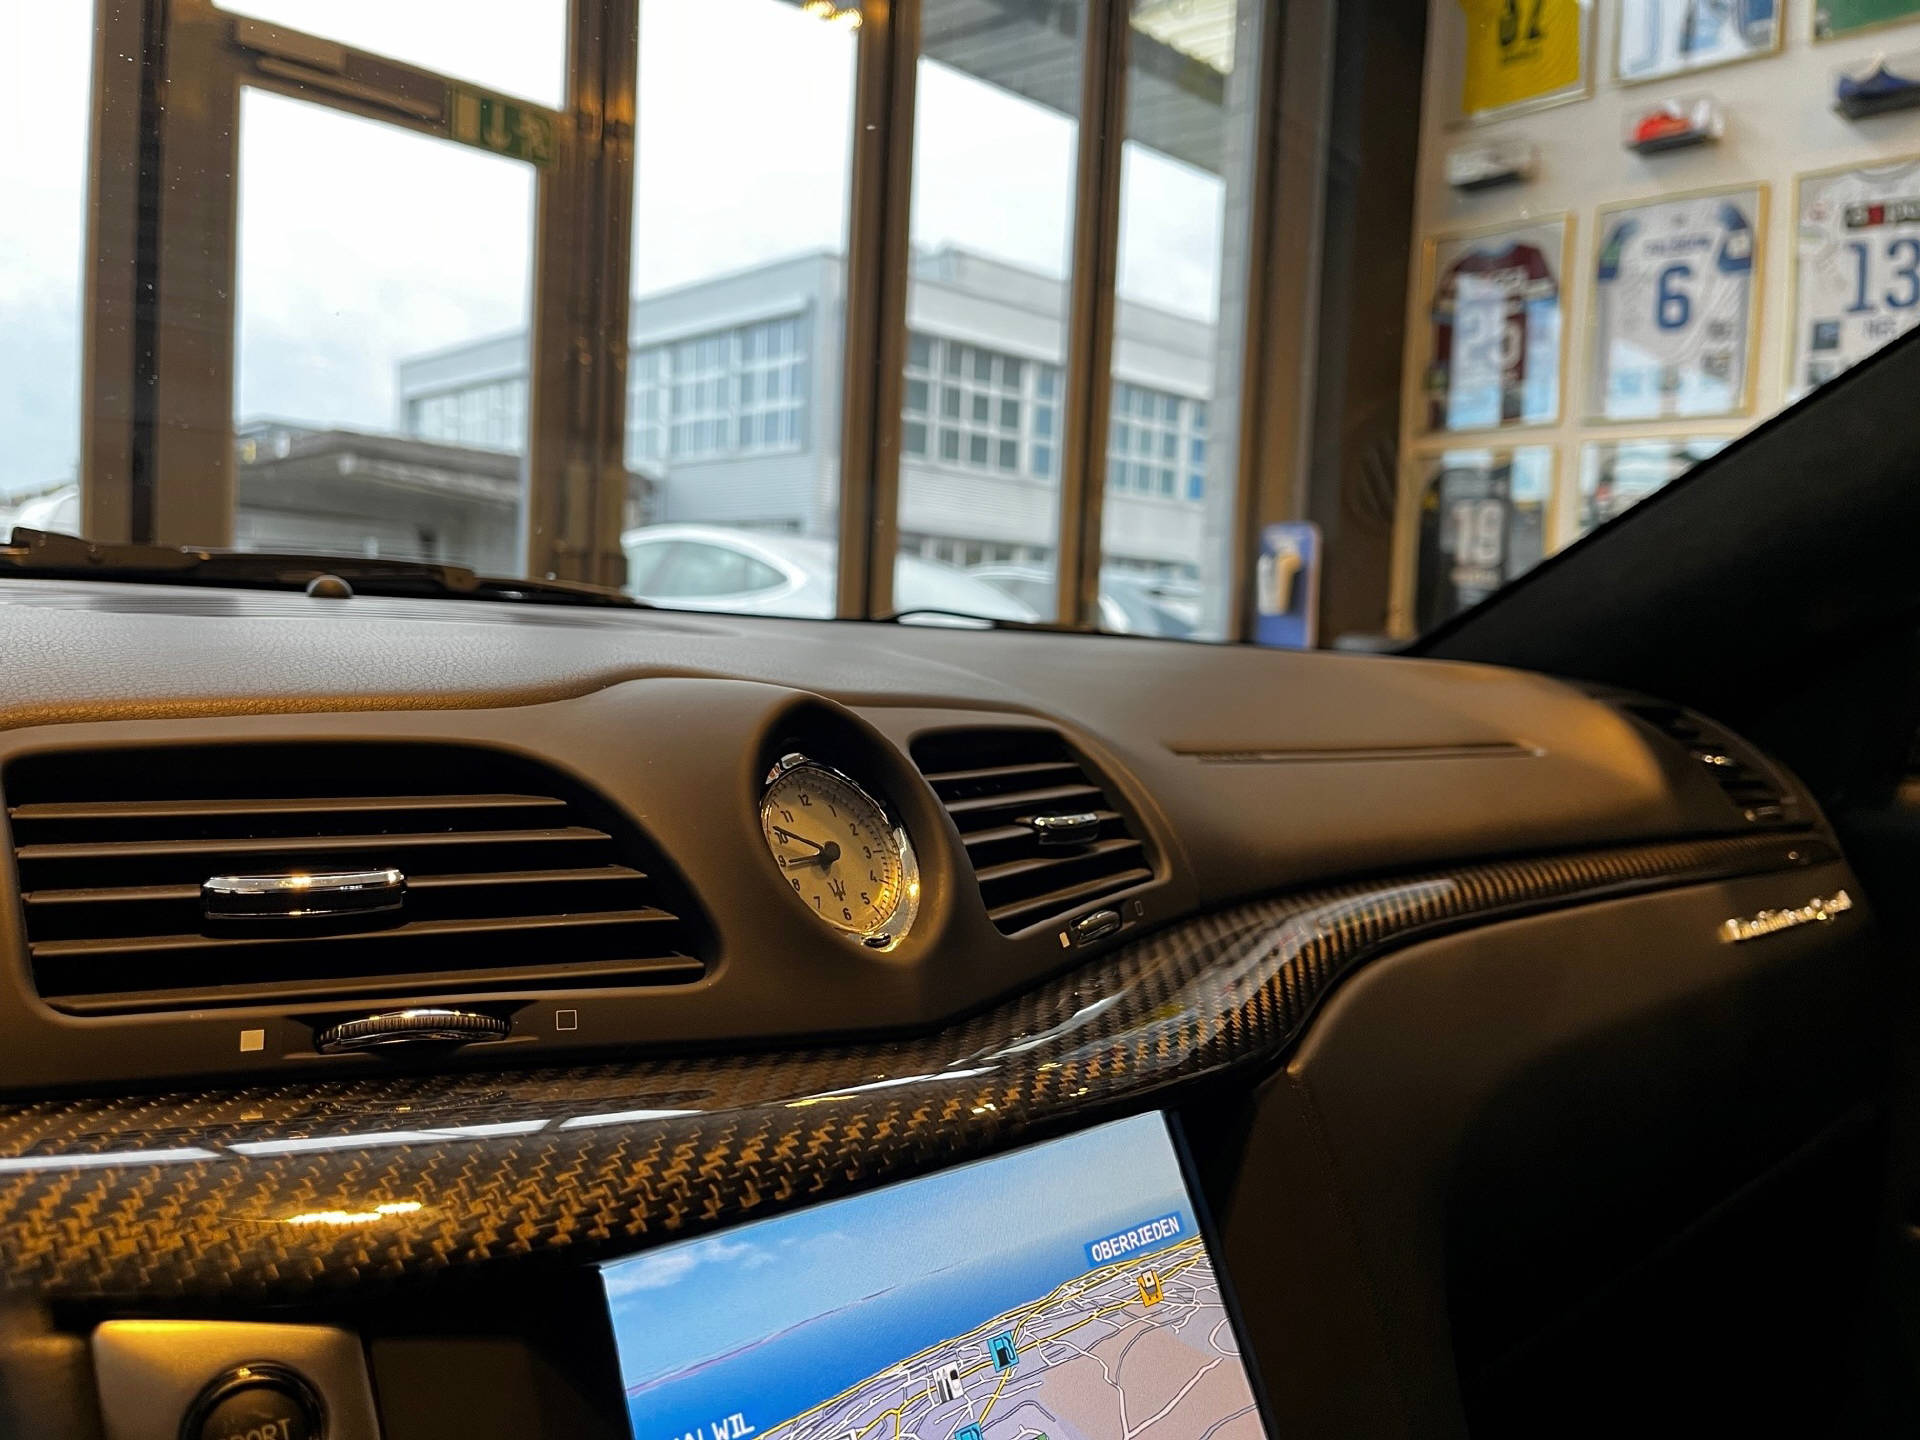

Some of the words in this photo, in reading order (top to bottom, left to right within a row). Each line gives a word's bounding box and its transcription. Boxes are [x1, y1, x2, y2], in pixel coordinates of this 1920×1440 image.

[1845, 238, 1920, 314] 13
[1657, 264, 1692, 330] 6
[798, 794, 812, 807] 12
[780, 809, 794, 823] 11
[850, 822, 859, 836] 2
[774, 831, 789, 845] 10
[863, 846, 872, 859] 3
[778, 855, 787, 868] 9
[870, 870, 878, 882] 4
[792, 879, 800, 892] 8
[813, 896, 821, 909] 7
[861, 892, 871, 905] 5
[843, 907, 852, 921] 6
[1091, 1216, 1180, 1262] OBERRIEDEN
